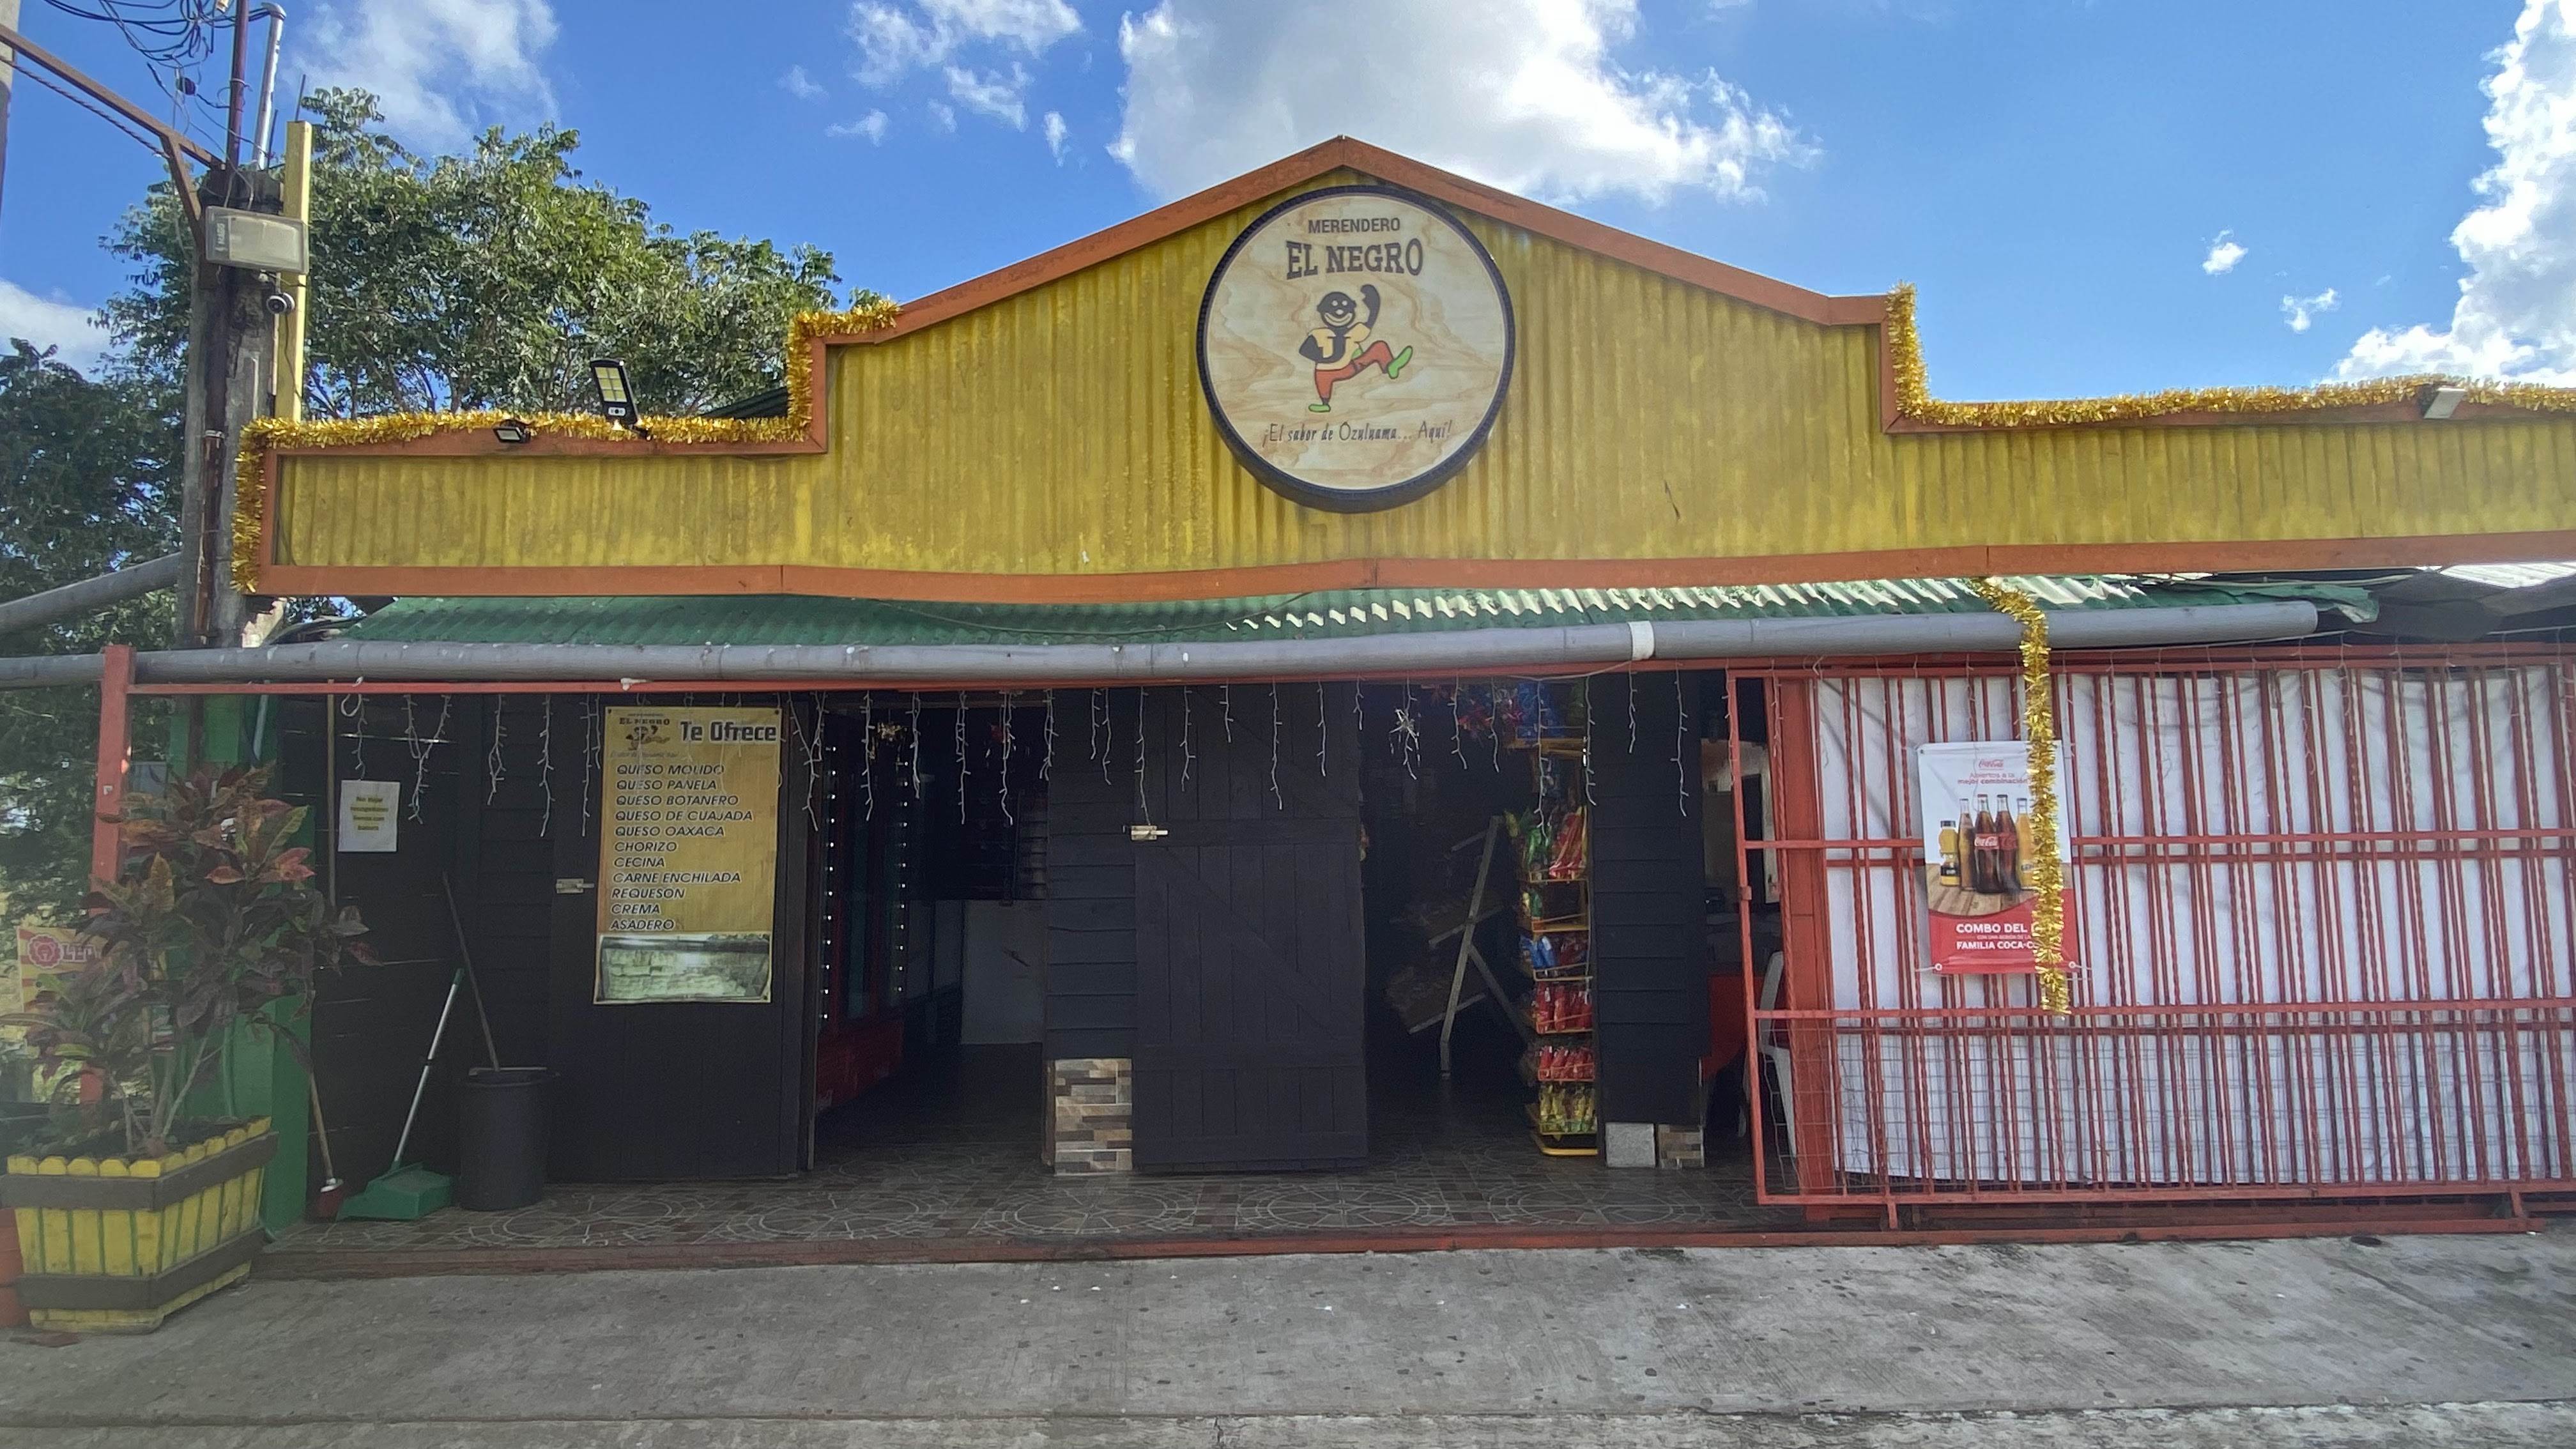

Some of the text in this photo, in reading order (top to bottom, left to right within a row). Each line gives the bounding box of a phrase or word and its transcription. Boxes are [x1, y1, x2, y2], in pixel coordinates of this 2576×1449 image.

[1308, 217, 1400, 233] MERENDERO
[1286, 238, 1423, 280] EL NEGRO
[1287, 424, 1316, 441] sabor
[1321, 423, 1333, 440] de
[680, 721, 776, 741] Te Ofrece
[617, 764, 724, 774] QUESO MOLIDO
[617, 780, 716, 790] QUESO PANELA
[616, 795, 739, 806] QUESO BOTANERO
[615, 811, 753, 821] QUESO DE CUAJADA
[615, 826, 724, 836] QUESO OAXACA
[614, 841, 677, 852] CHORIZO
[614, 857, 666, 867] CECINA
[613, 872, 741, 883] CARNE ENCHILADA
[611, 888, 685, 898] REQUESON
[611, 903, 661, 914] CREMA
[610, 919, 675, 930] ASADERO
[1956, 923, 2001, 933] COMBO
[2004, 923, 2028, 933] DEL
[1956, 941, 2037, 949] FAMILIA COCA-C
